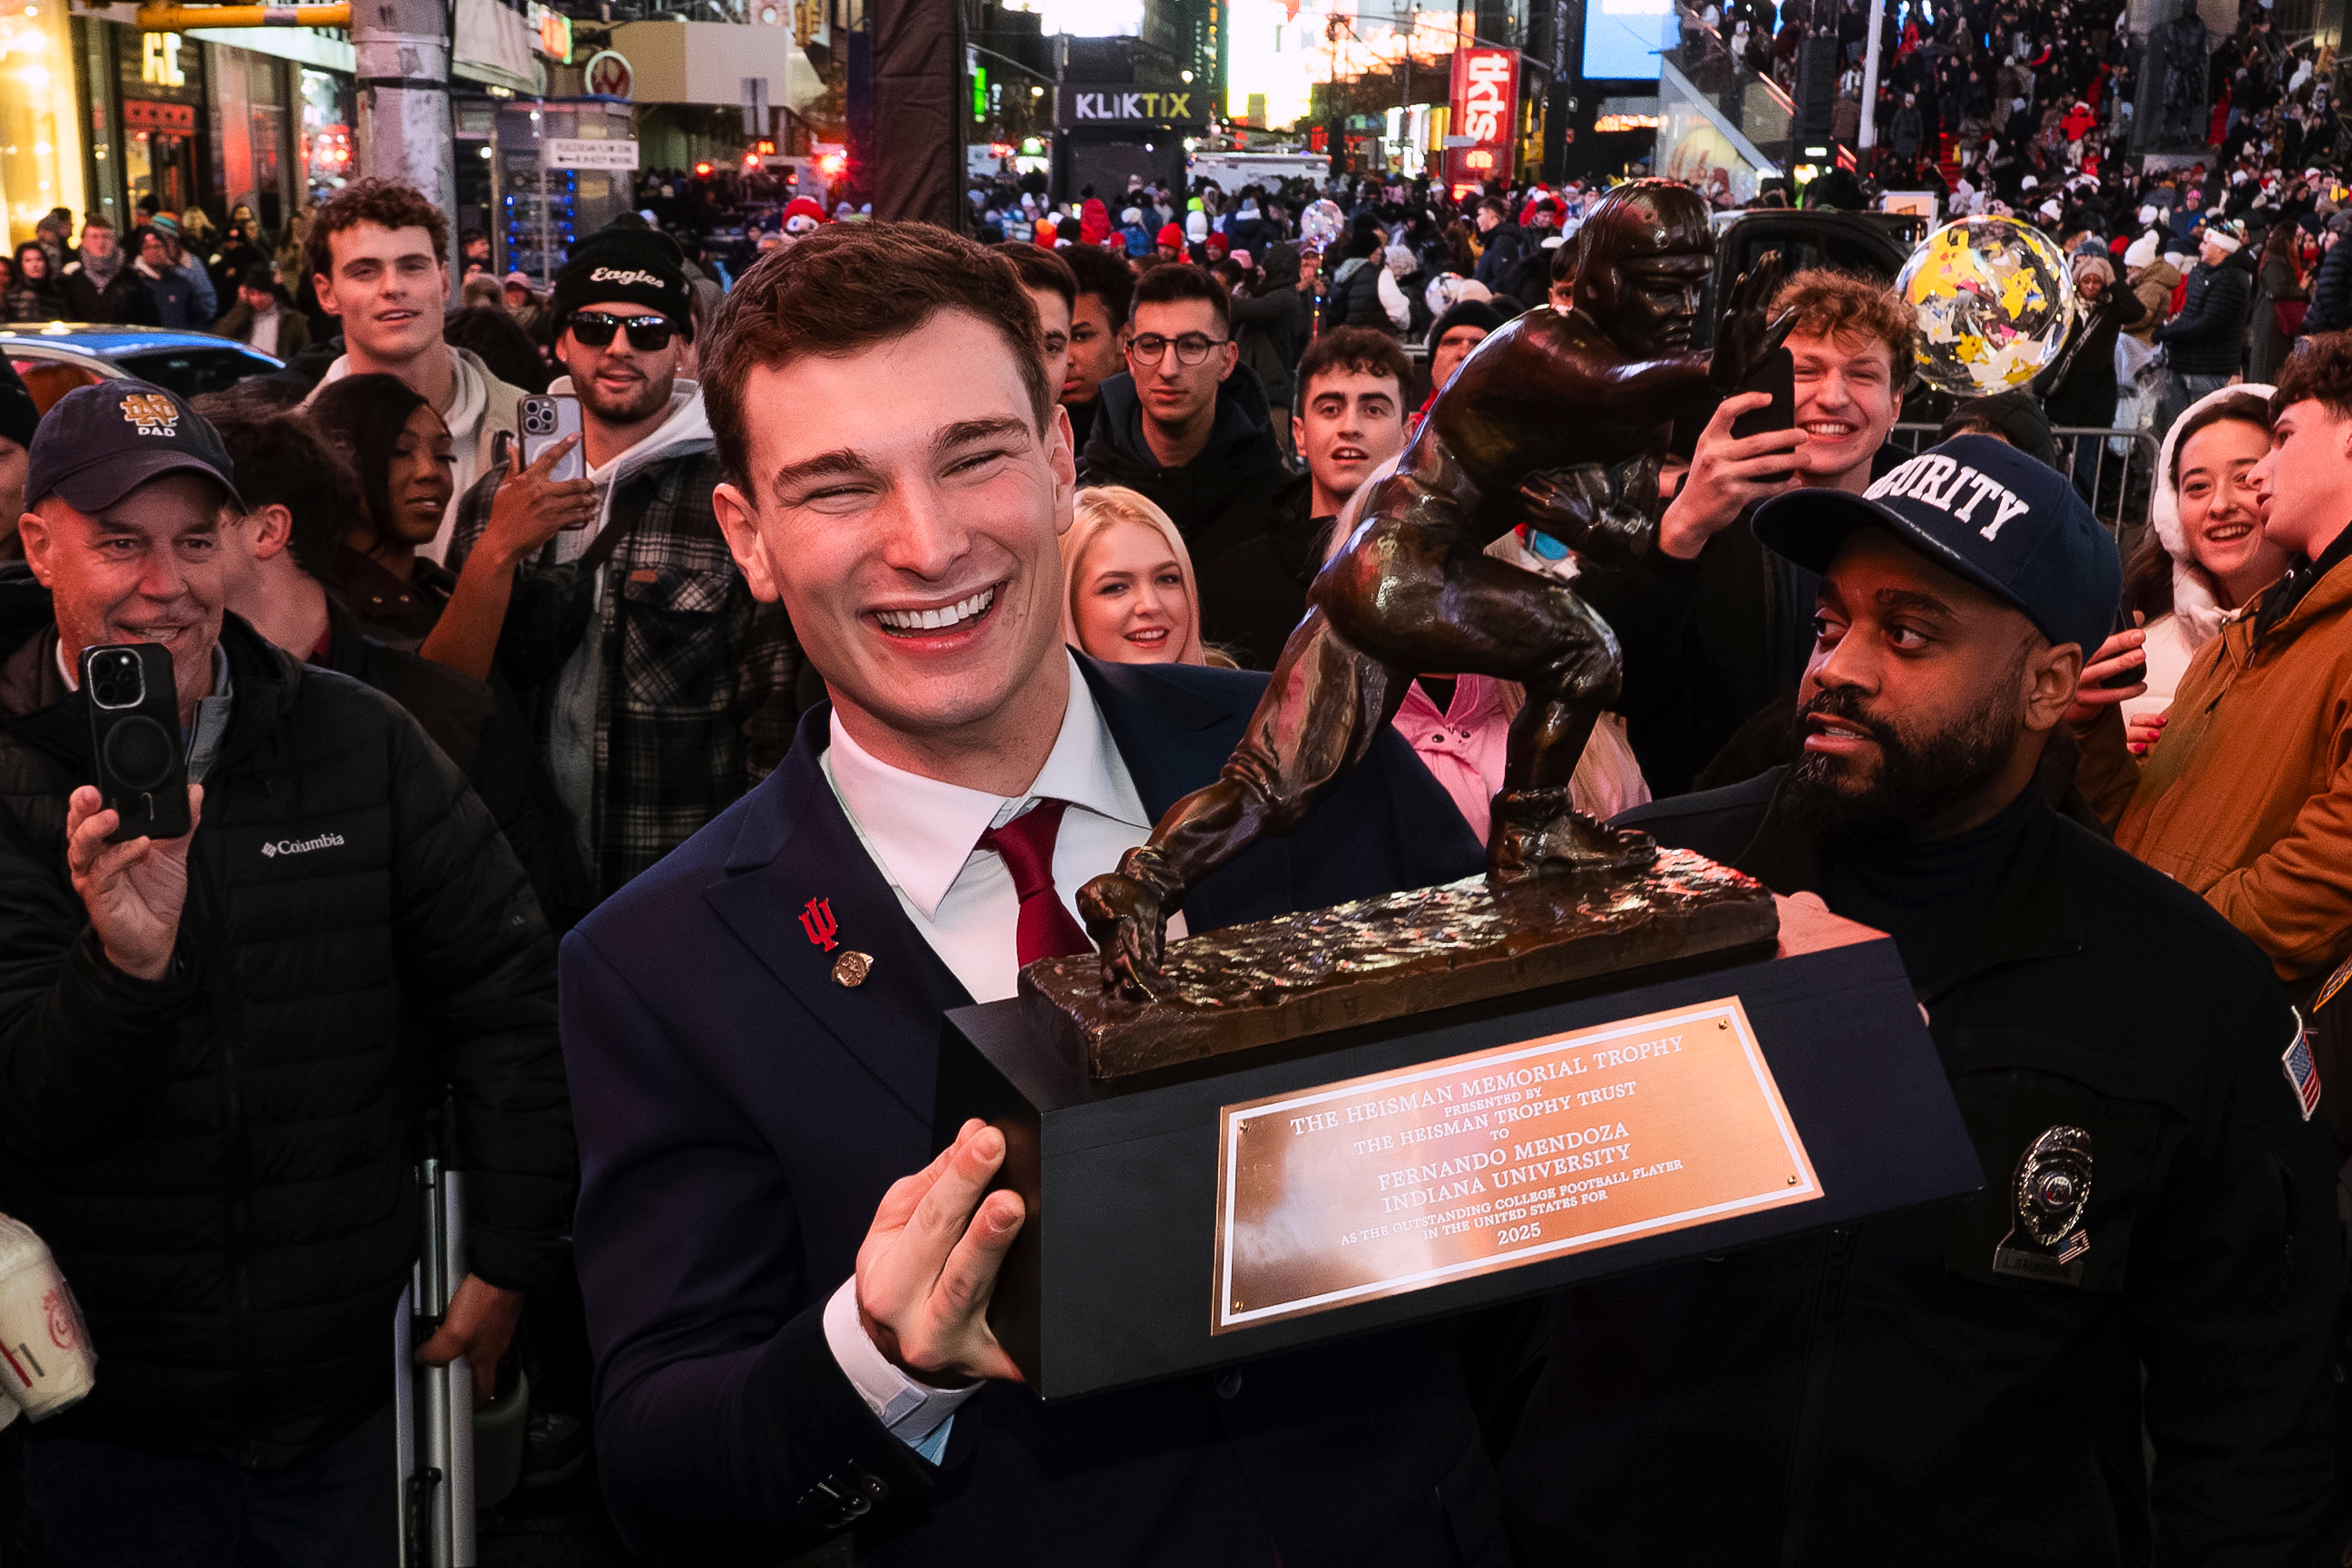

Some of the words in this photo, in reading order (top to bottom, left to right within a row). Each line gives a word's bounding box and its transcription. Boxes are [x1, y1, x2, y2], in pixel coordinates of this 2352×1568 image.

[1076, 93, 1192, 119] KLIKTIX
[1464, 54, 1510, 141] tkts
[590, 267, 665, 288] Eagles
[137, 426, 176, 437] DAD
[277, 833, 345, 855] Columbia
[1290, 1111, 1339, 1135] THE
[1346, 1086, 1453, 1124] HEISMAN
[1461, 1057, 1588, 1099] MEMORIAL
[1593, 1035, 1684, 1070] TROPHY
[1444, 1091, 1523, 1118] PRESENTED
[1524, 1086, 1543, 1100] BY
[1353, 1135, 1394, 1155] THE
[1400, 1114, 1489, 1146] HEISMAN
[1494, 1095, 1573, 1125] TROPHY
[1576, 1081, 1637, 1107] TRUST
[1489, 1127, 1510, 1142] TO
[1377, 1148, 1508, 1191] FERNANDO
[1514, 1121, 1630, 1162] MENDOZA
[1382, 1177, 1488, 1213] INDIANA
[1491, 1143, 1631, 1190] UNIVERSITY
[1341, 1232, 1358, 1246] AS
[1361, 1224, 1390, 1241] THE
[1392, 1202, 1492, 1233] OUTSTANDING
[1495, 1188, 1557, 1212] COLLEGE
[1559, 1172, 1630, 1196] FOOTBALL
[1632, 1159, 1684, 1181] PLAYER
[1422, 1227, 1440, 1242] IN
[1442, 1221, 1470, 1237] THE
[1473, 1207, 1527, 1229] UNITED
[1529, 1195, 1578, 1217] STATES
[1580, 1188, 1609, 1205] FOR
[1497, 1222, 1543, 1246] 2025
